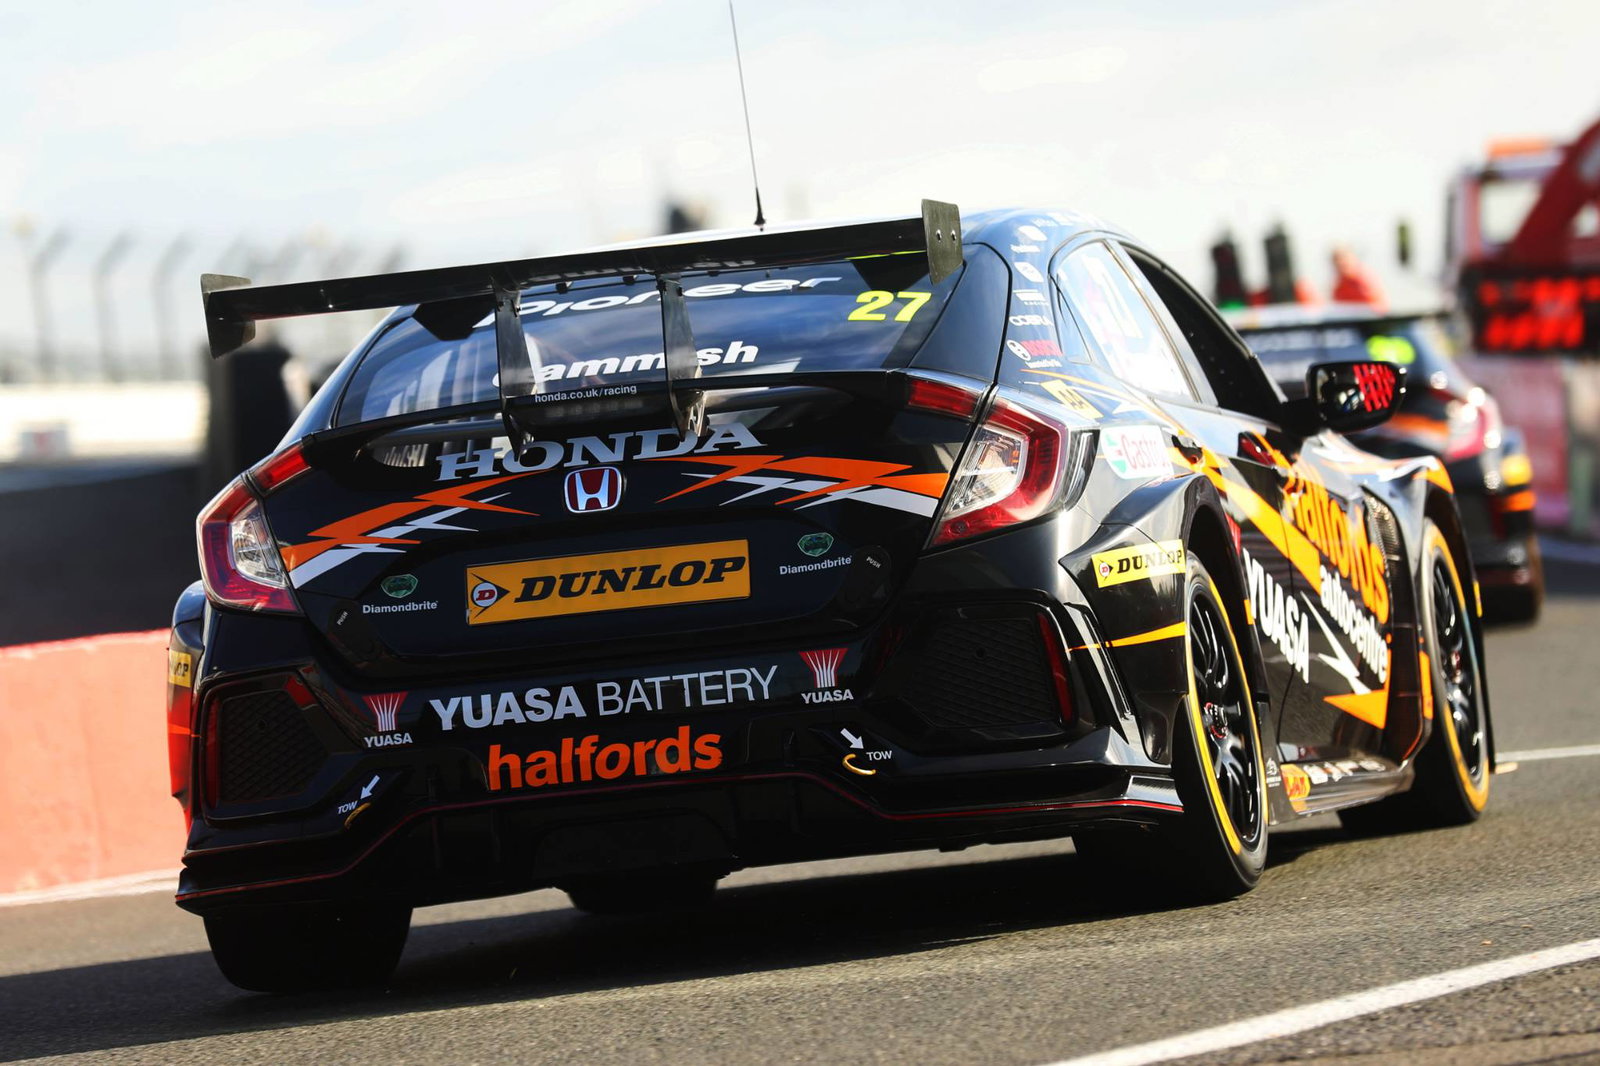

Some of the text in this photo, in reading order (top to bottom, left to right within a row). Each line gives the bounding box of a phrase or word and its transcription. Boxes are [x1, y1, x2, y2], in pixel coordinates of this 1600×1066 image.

[847, 290, 932, 322] 27
[492, 340, 759, 388] ammsh
[534, 383, 637, 403] honda.co.uk/racing
[433, 422, 768, 482] HONDA
[1120, 433, 1171, 471] Castr
[779, 555, 852, 575] Diamondbrite
[866, 556, 881, 569] PUSH
[1117, 549, 1183, 575] DUNLOP
[514, 556, 747, 603] DUNLOP
[362, 600, 439, 615] Diamondbrite
[1243, 547, 1310, 684] YUASA
[428, 665, 779, 731] YUASA BATTERY
[801, 688, 854, 705] YUASA
[364, 732, 414, 748] YUASA
[488, 725, 724, 791] halfords
[866, 750, 893, 762] TOW
[337, 800, 359, 815] TOW
